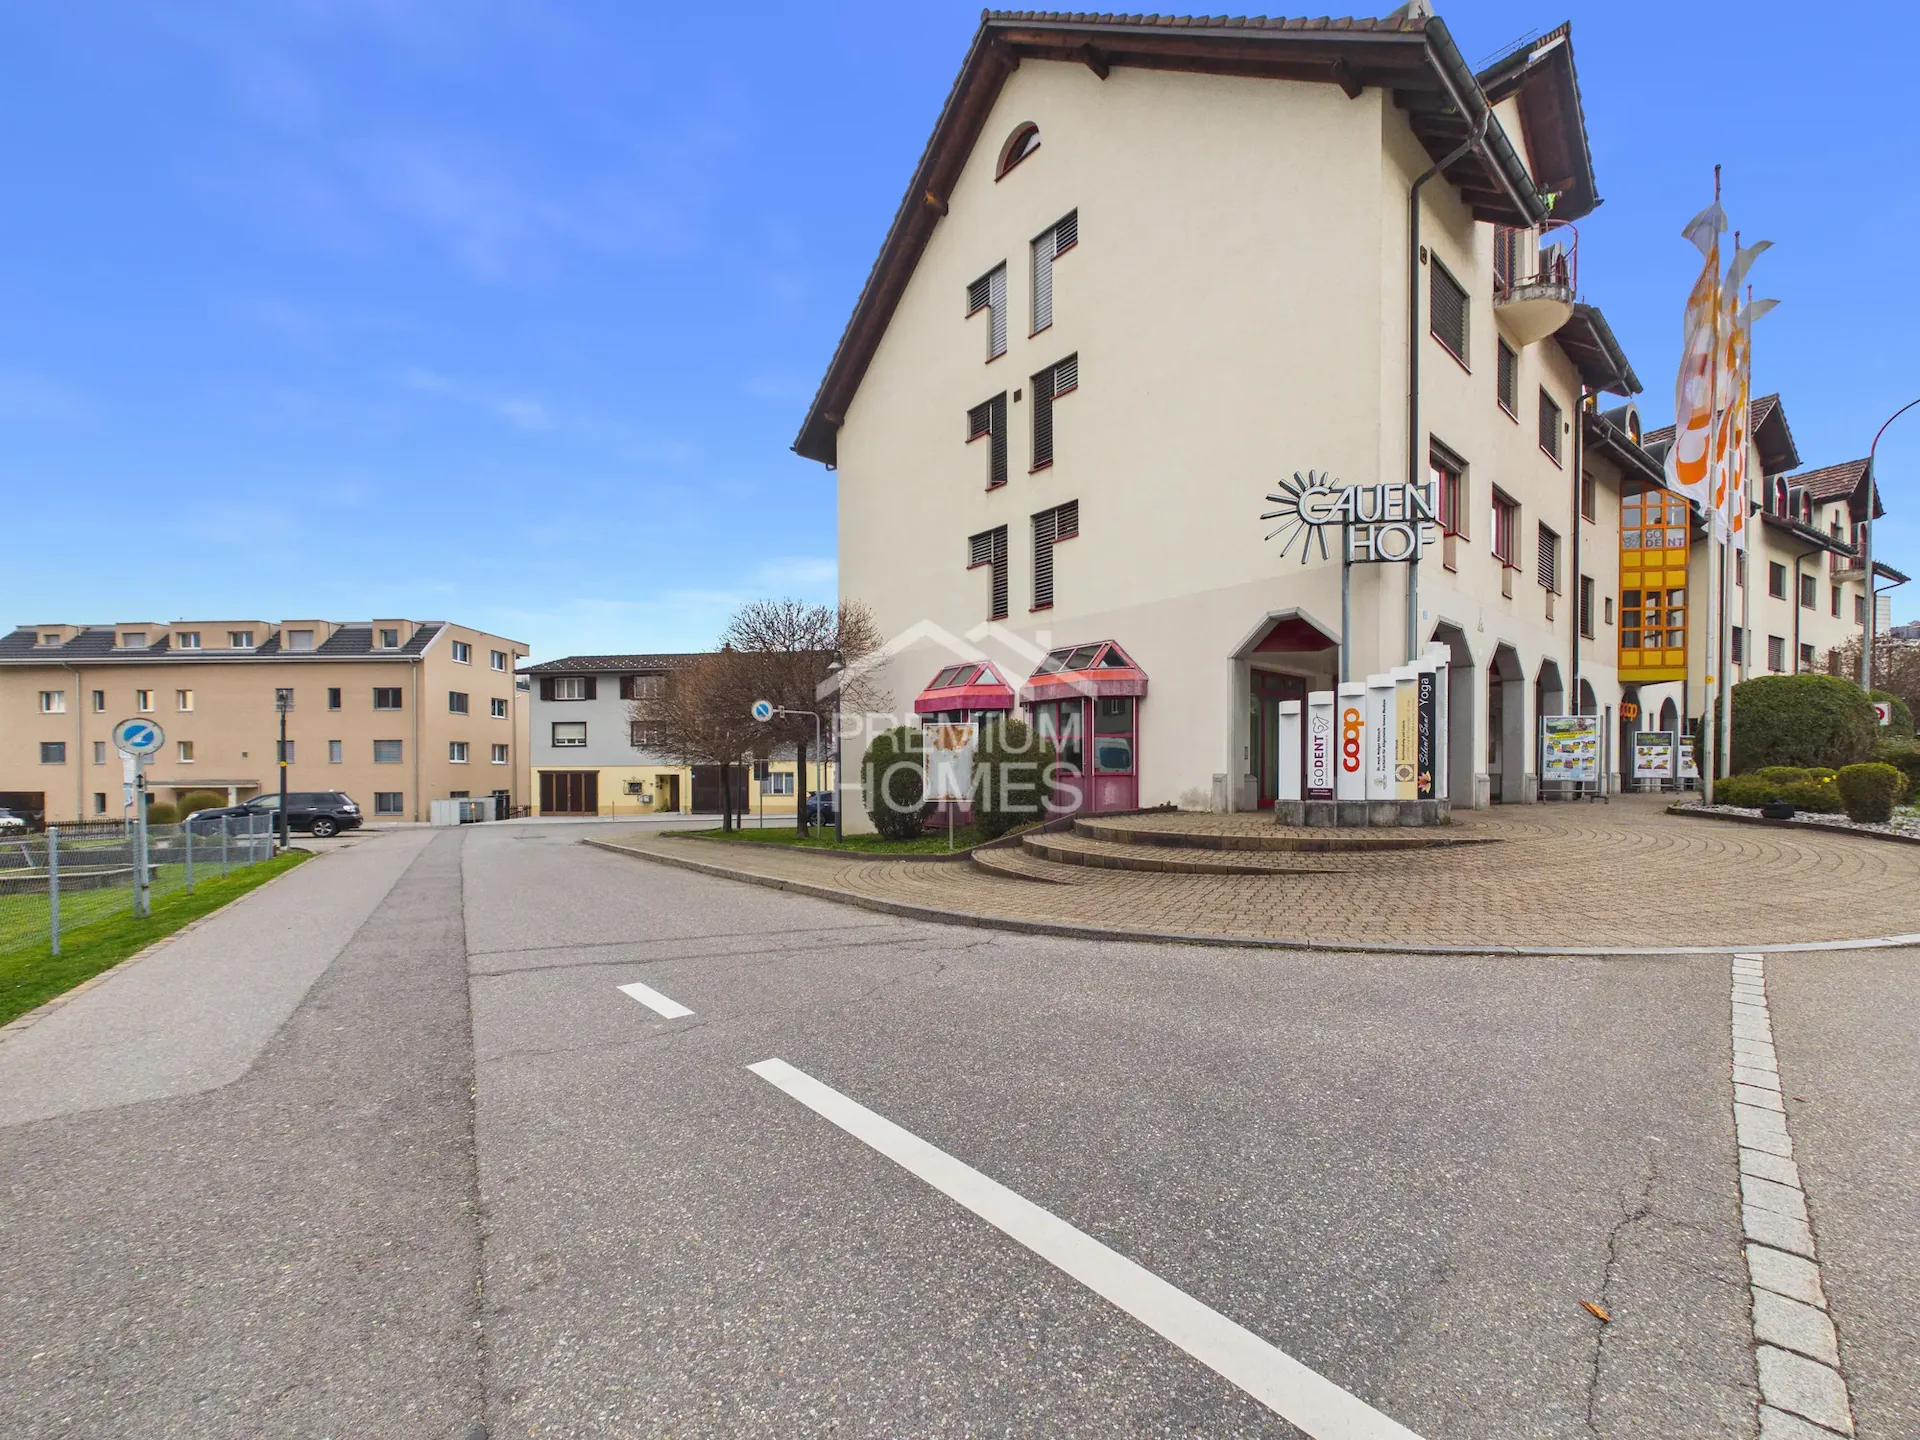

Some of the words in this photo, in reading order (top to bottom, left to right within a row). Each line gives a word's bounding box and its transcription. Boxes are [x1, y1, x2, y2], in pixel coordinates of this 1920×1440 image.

[1299, 482, 1437, 524] GAUEN
[1346, 522, 1436, 562] HOF
[1645, 530, 1663, 539] GO
[1645, 537, 1685, 547] DENT
[1419, 678, 1431, 707] Yoga
[1343, 708, 1364, 772] coop
[1419, 735, 1429, 766] Silent
[1313, 735, 1324, 787] GODENT
